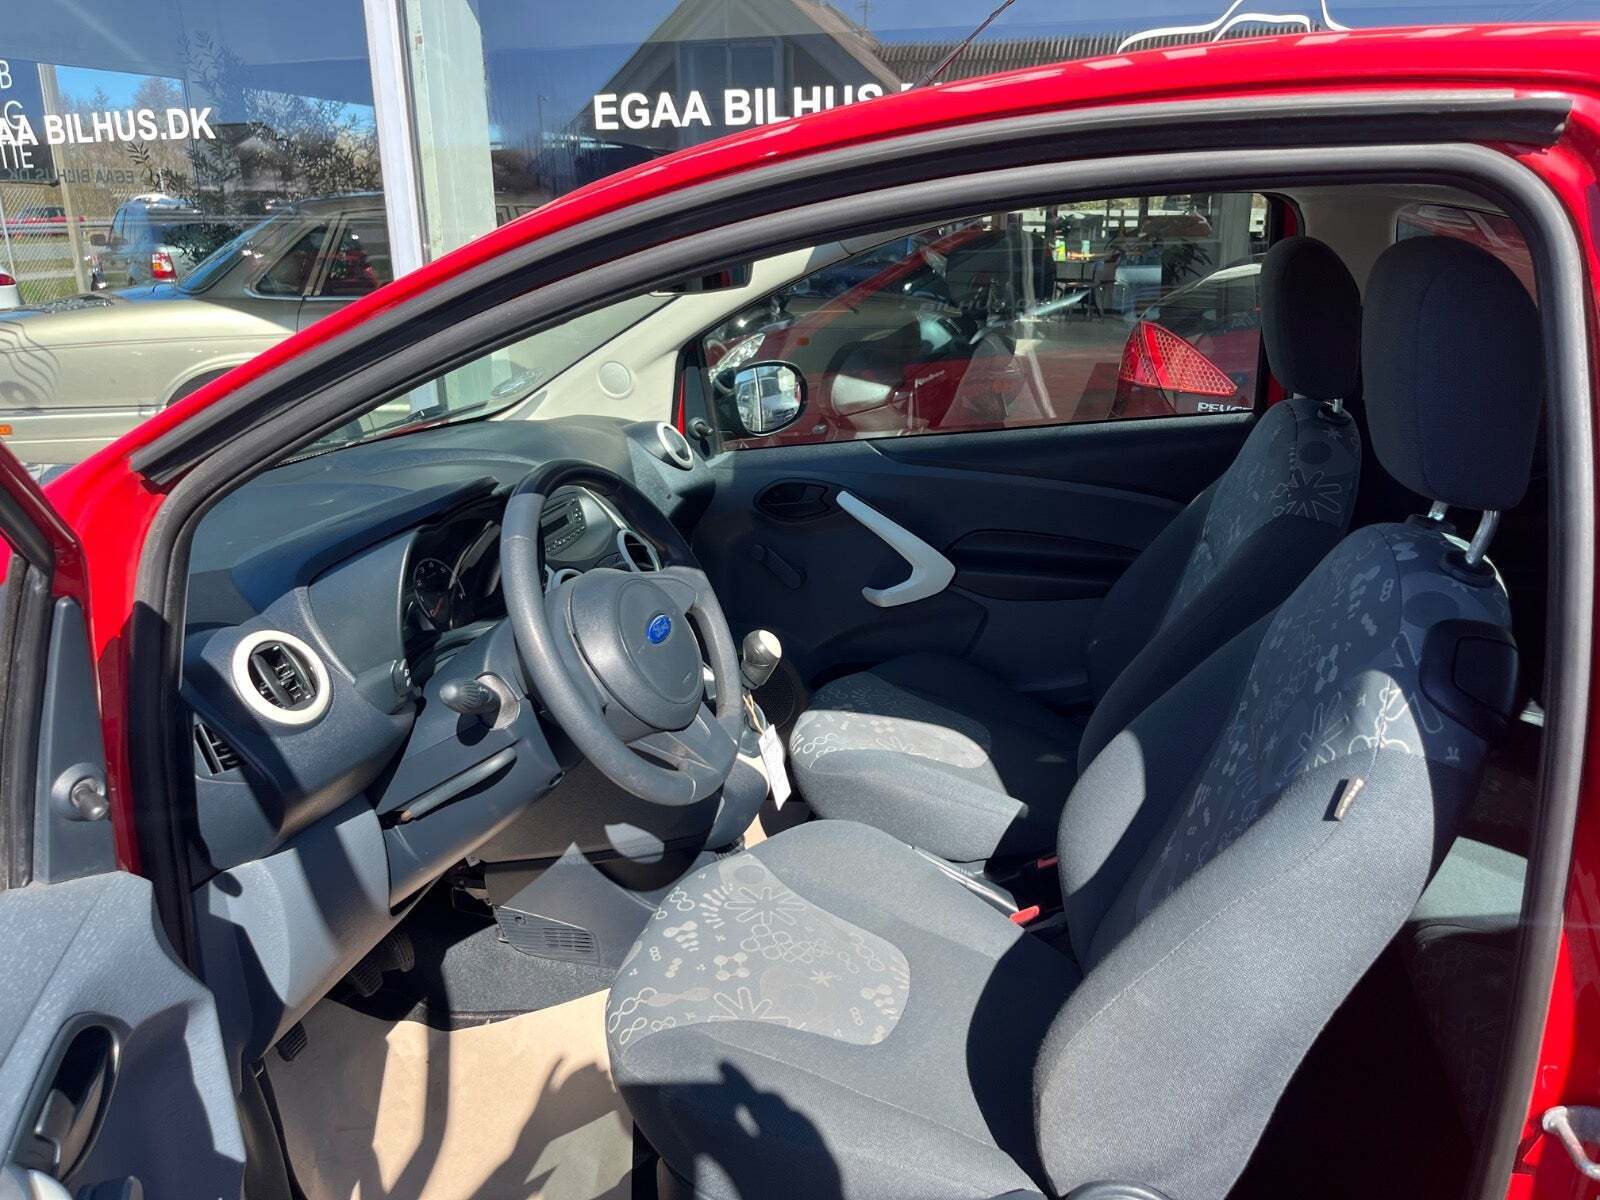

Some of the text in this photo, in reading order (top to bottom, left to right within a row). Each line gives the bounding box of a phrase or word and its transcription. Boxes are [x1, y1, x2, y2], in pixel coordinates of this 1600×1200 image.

[43, 107, 216, 145] BILHUS.DK
[593, 83, 943, 130] EGAA BILHU
